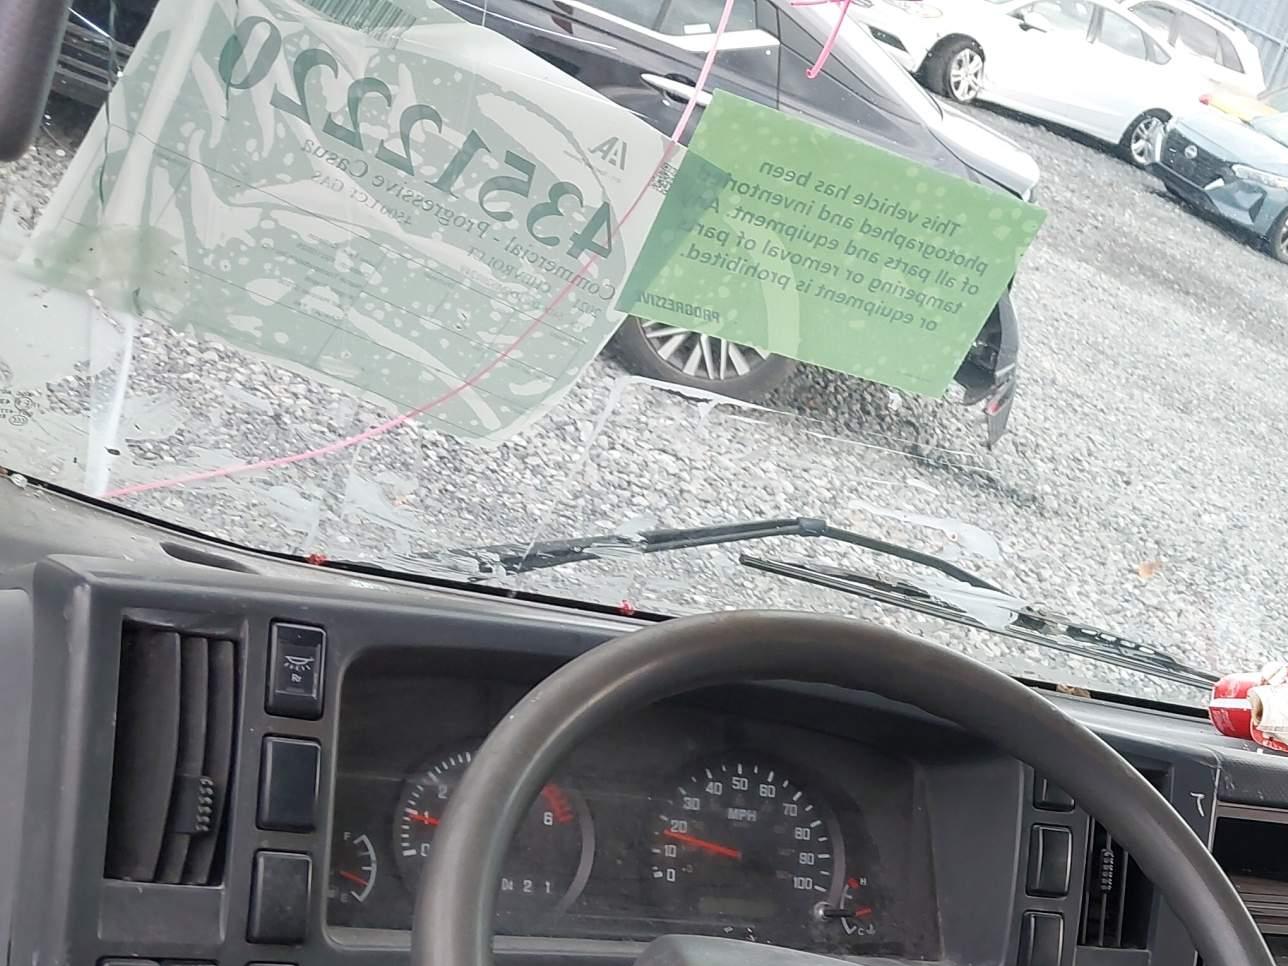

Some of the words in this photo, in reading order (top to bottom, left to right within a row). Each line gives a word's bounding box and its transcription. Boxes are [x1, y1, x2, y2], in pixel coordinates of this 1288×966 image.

[705, 782, 723, 796] 40
[732, 776, 748, 790] 50
[437, 785, 448, 800] 2
[759, 784, 776, 798] 60
[683, 797, 701, 811] 30
[783, 803, 798, 817] 70
[543, 811, 553, 826] 6
[727, 808, 757, 822] MPH
[670, 820, 688, 834] 20
[794, 827, 811, 841] 80
[344, 831, 351, 841] F
[664, 844, 677, 858] 10
[798, 852, 815, 866] 90
[666, 867, 676, 882] 0
[523, 880, 534, 893] 2
[544, 881, 551, 894] 1
[793, 877, 813, 890] 100
